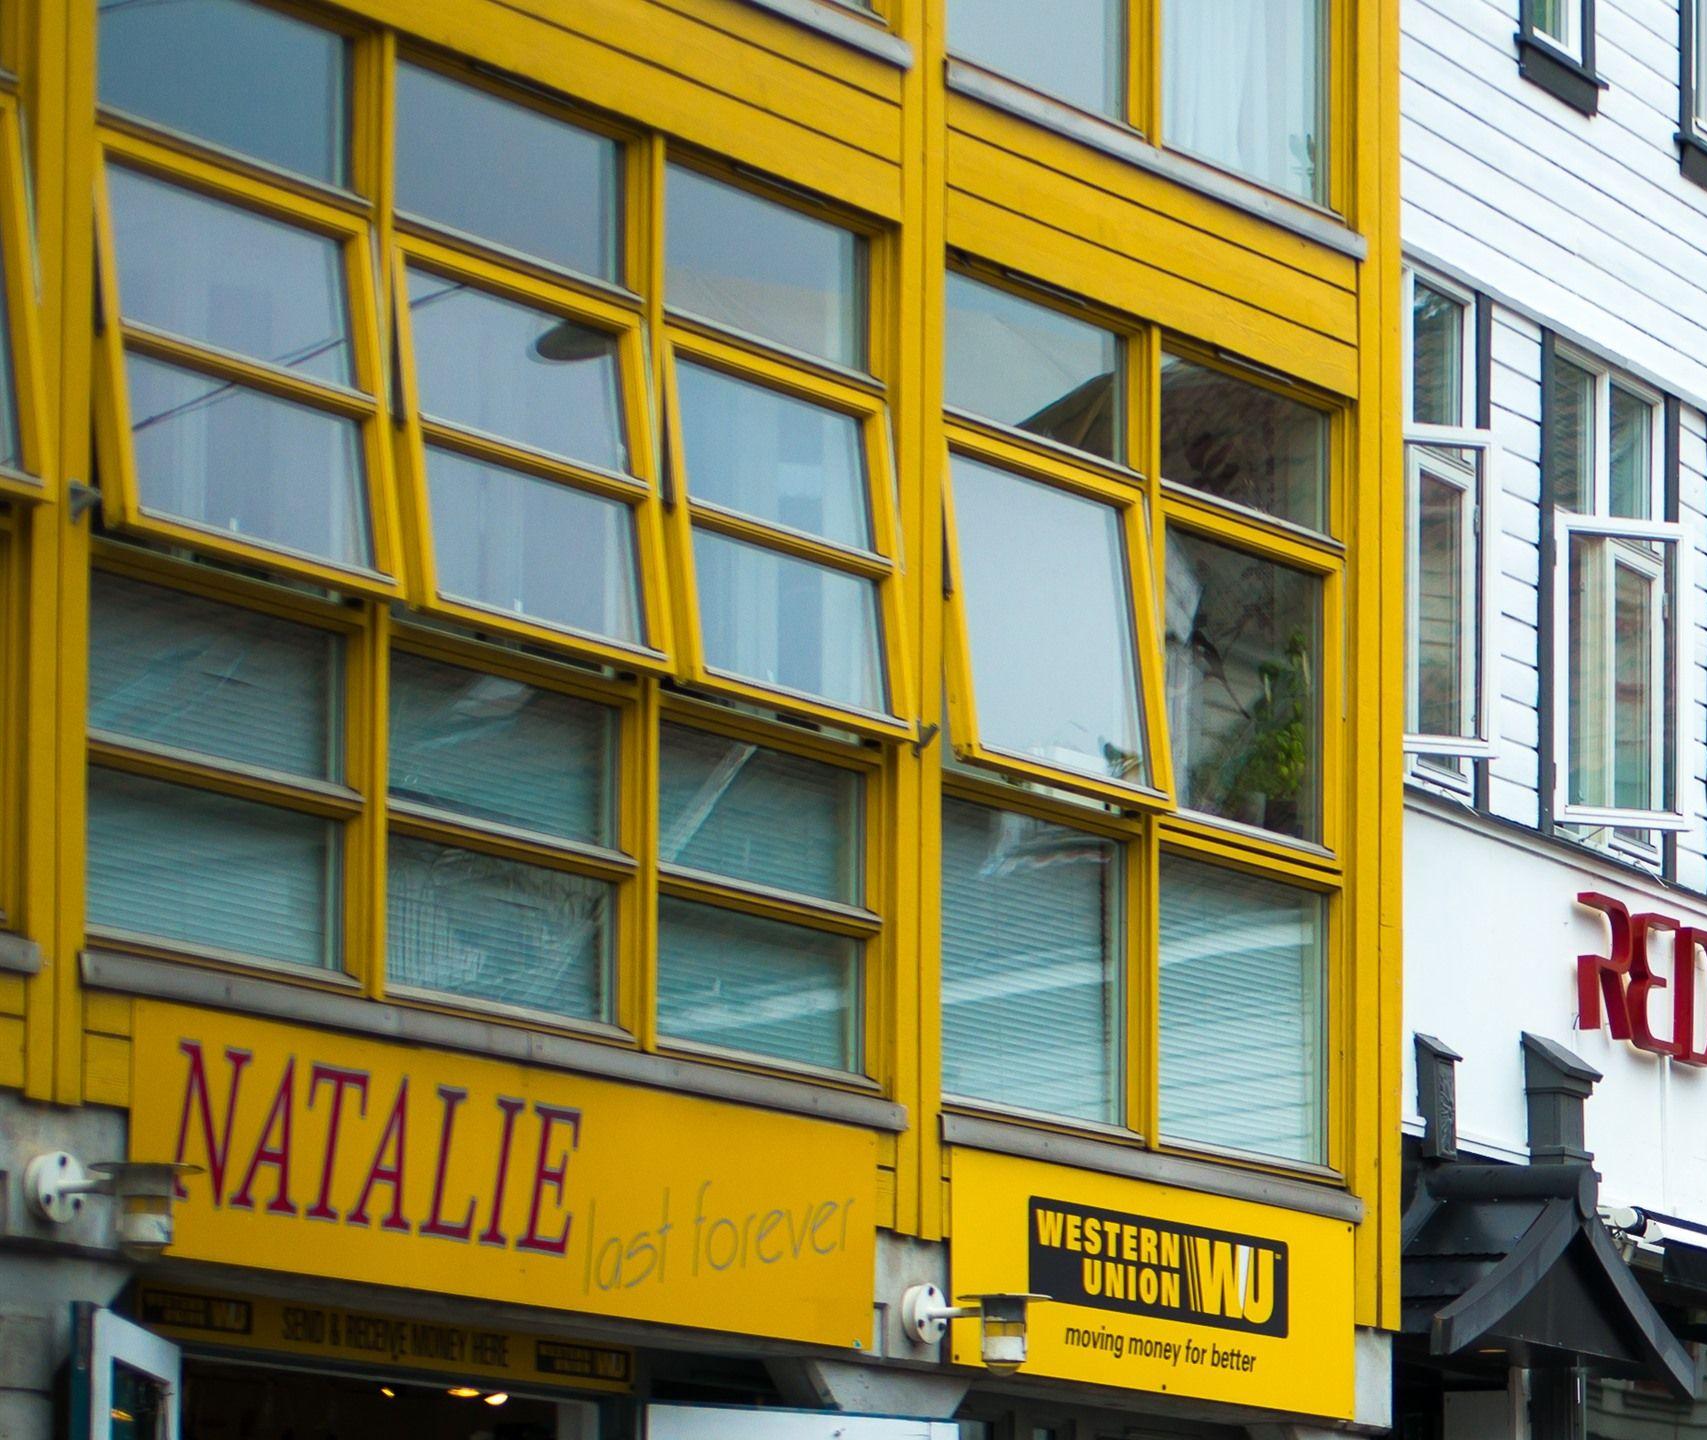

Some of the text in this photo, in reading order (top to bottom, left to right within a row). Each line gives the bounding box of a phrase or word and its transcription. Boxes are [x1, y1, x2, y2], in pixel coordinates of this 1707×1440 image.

[173, 1038, 582, 1257] NATALIE
[582, 1179, 856, 1297] last forever
[1034, 1207, 1182, 1270] WESTERN
[1081, 1259, 1182, 1309] UNION
[1197, 1236, 1275, 1325] WU
[1064, 1326, 1257, 1374] moving money for better
